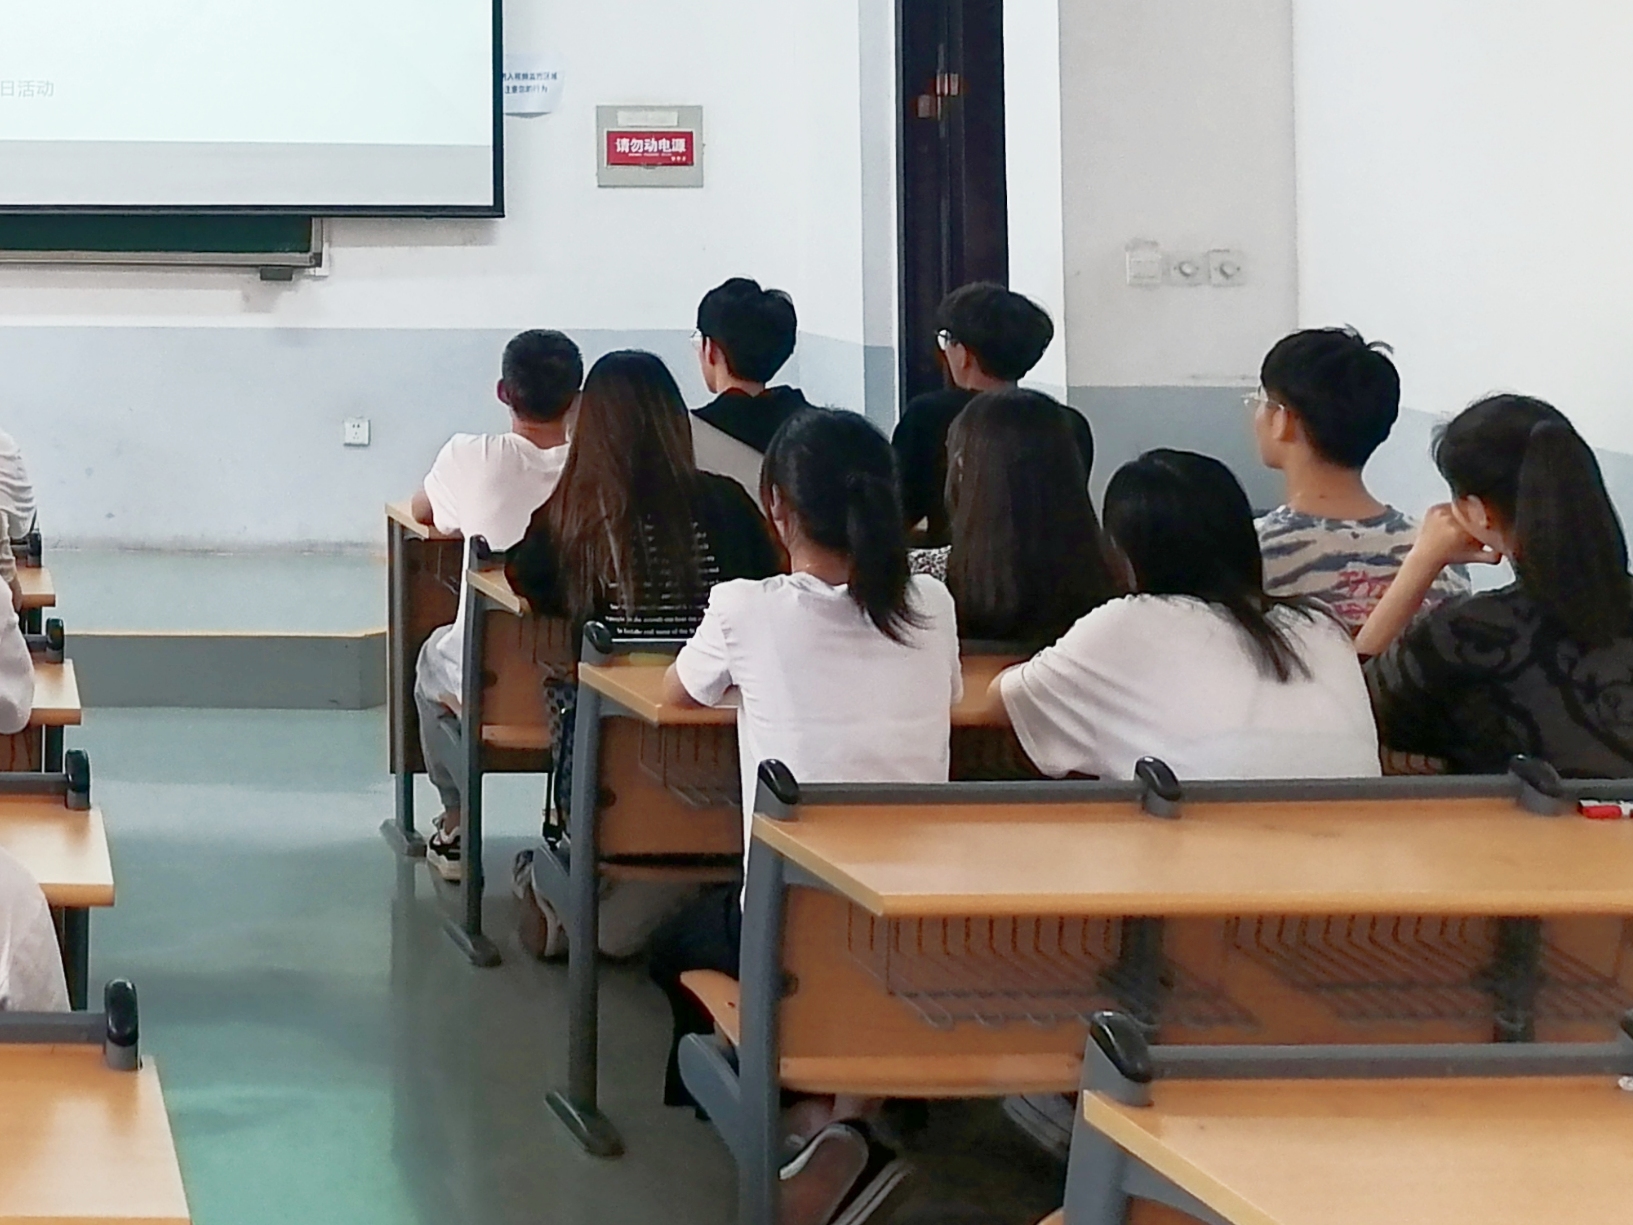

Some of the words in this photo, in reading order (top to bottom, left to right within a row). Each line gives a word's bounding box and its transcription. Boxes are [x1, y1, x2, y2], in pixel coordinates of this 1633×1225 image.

[615, 137, 687, 153] 请勿动电源
